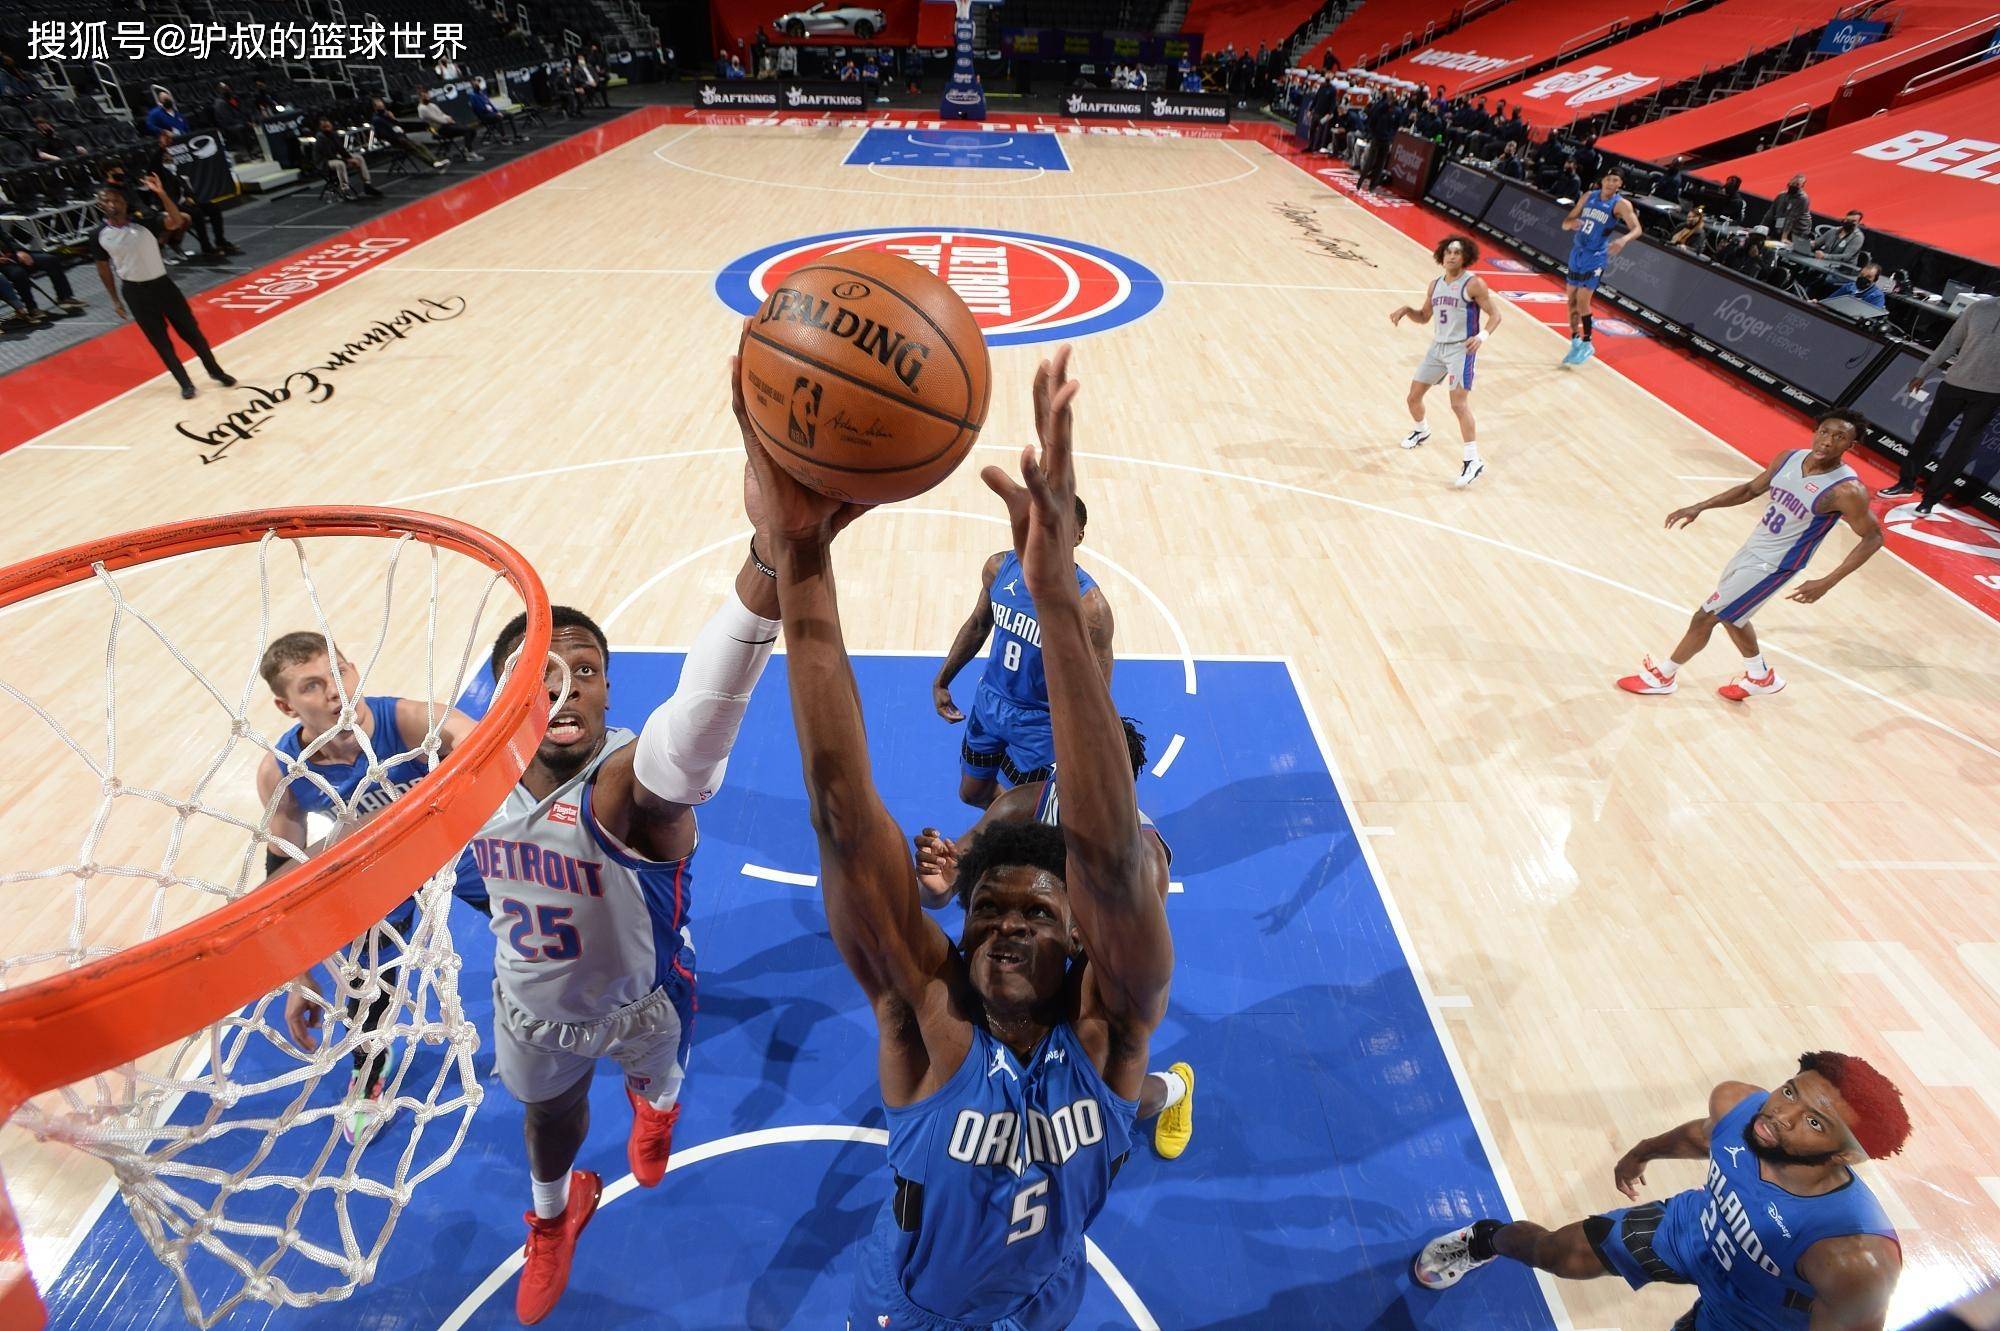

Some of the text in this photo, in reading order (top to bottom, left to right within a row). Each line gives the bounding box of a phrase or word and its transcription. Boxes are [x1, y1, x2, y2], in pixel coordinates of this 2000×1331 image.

[1833, 25, 1865, 53] Kroger
[702, 87, 777, 105] DRAFTKINGS
[788, 89, 863, 107] DRAFTKINGS
[1068, 96, 1142, 115] DRAFTKINGS
[1153, 99, 1226, 118] DRAFTKINGS
[1508, 197, 1540, 233] Kroger
[1582, 219, 1595, 235] 13
[947, 246, 1012, 317] DETROIT
[1432, 296, 1459, 308] DETROIT
[1440, 309, 1448, 324] 5
[1713, 294, 1775, 342] Kroger
[760, 287, 930, 394] SPALDING
[1775, 322, 1794, 336] FOR
[175, 296, 466, 465] Platinum Equity
[1761, 505, 1787, 535] 38
[1769, 485, 1811, 521] DETROIT
[991, 600, 1042, 649] ORLAN
[1003, 639, 1022, 672] 8
[553, 803, 577, 816] Flagstar
[473, 838, 604, 898] DETROIT
[502, 898, 584, 961] 25
[948, 1098, 1104, 1178] ORLNDO
[1006, 1178, 1049, 1246] 5
[1708, 1158, 1781, 1277] RLANDO
[1767, 1200, 1792, 1239] Disney
[1699, 1198, 1737, 1272] 25
